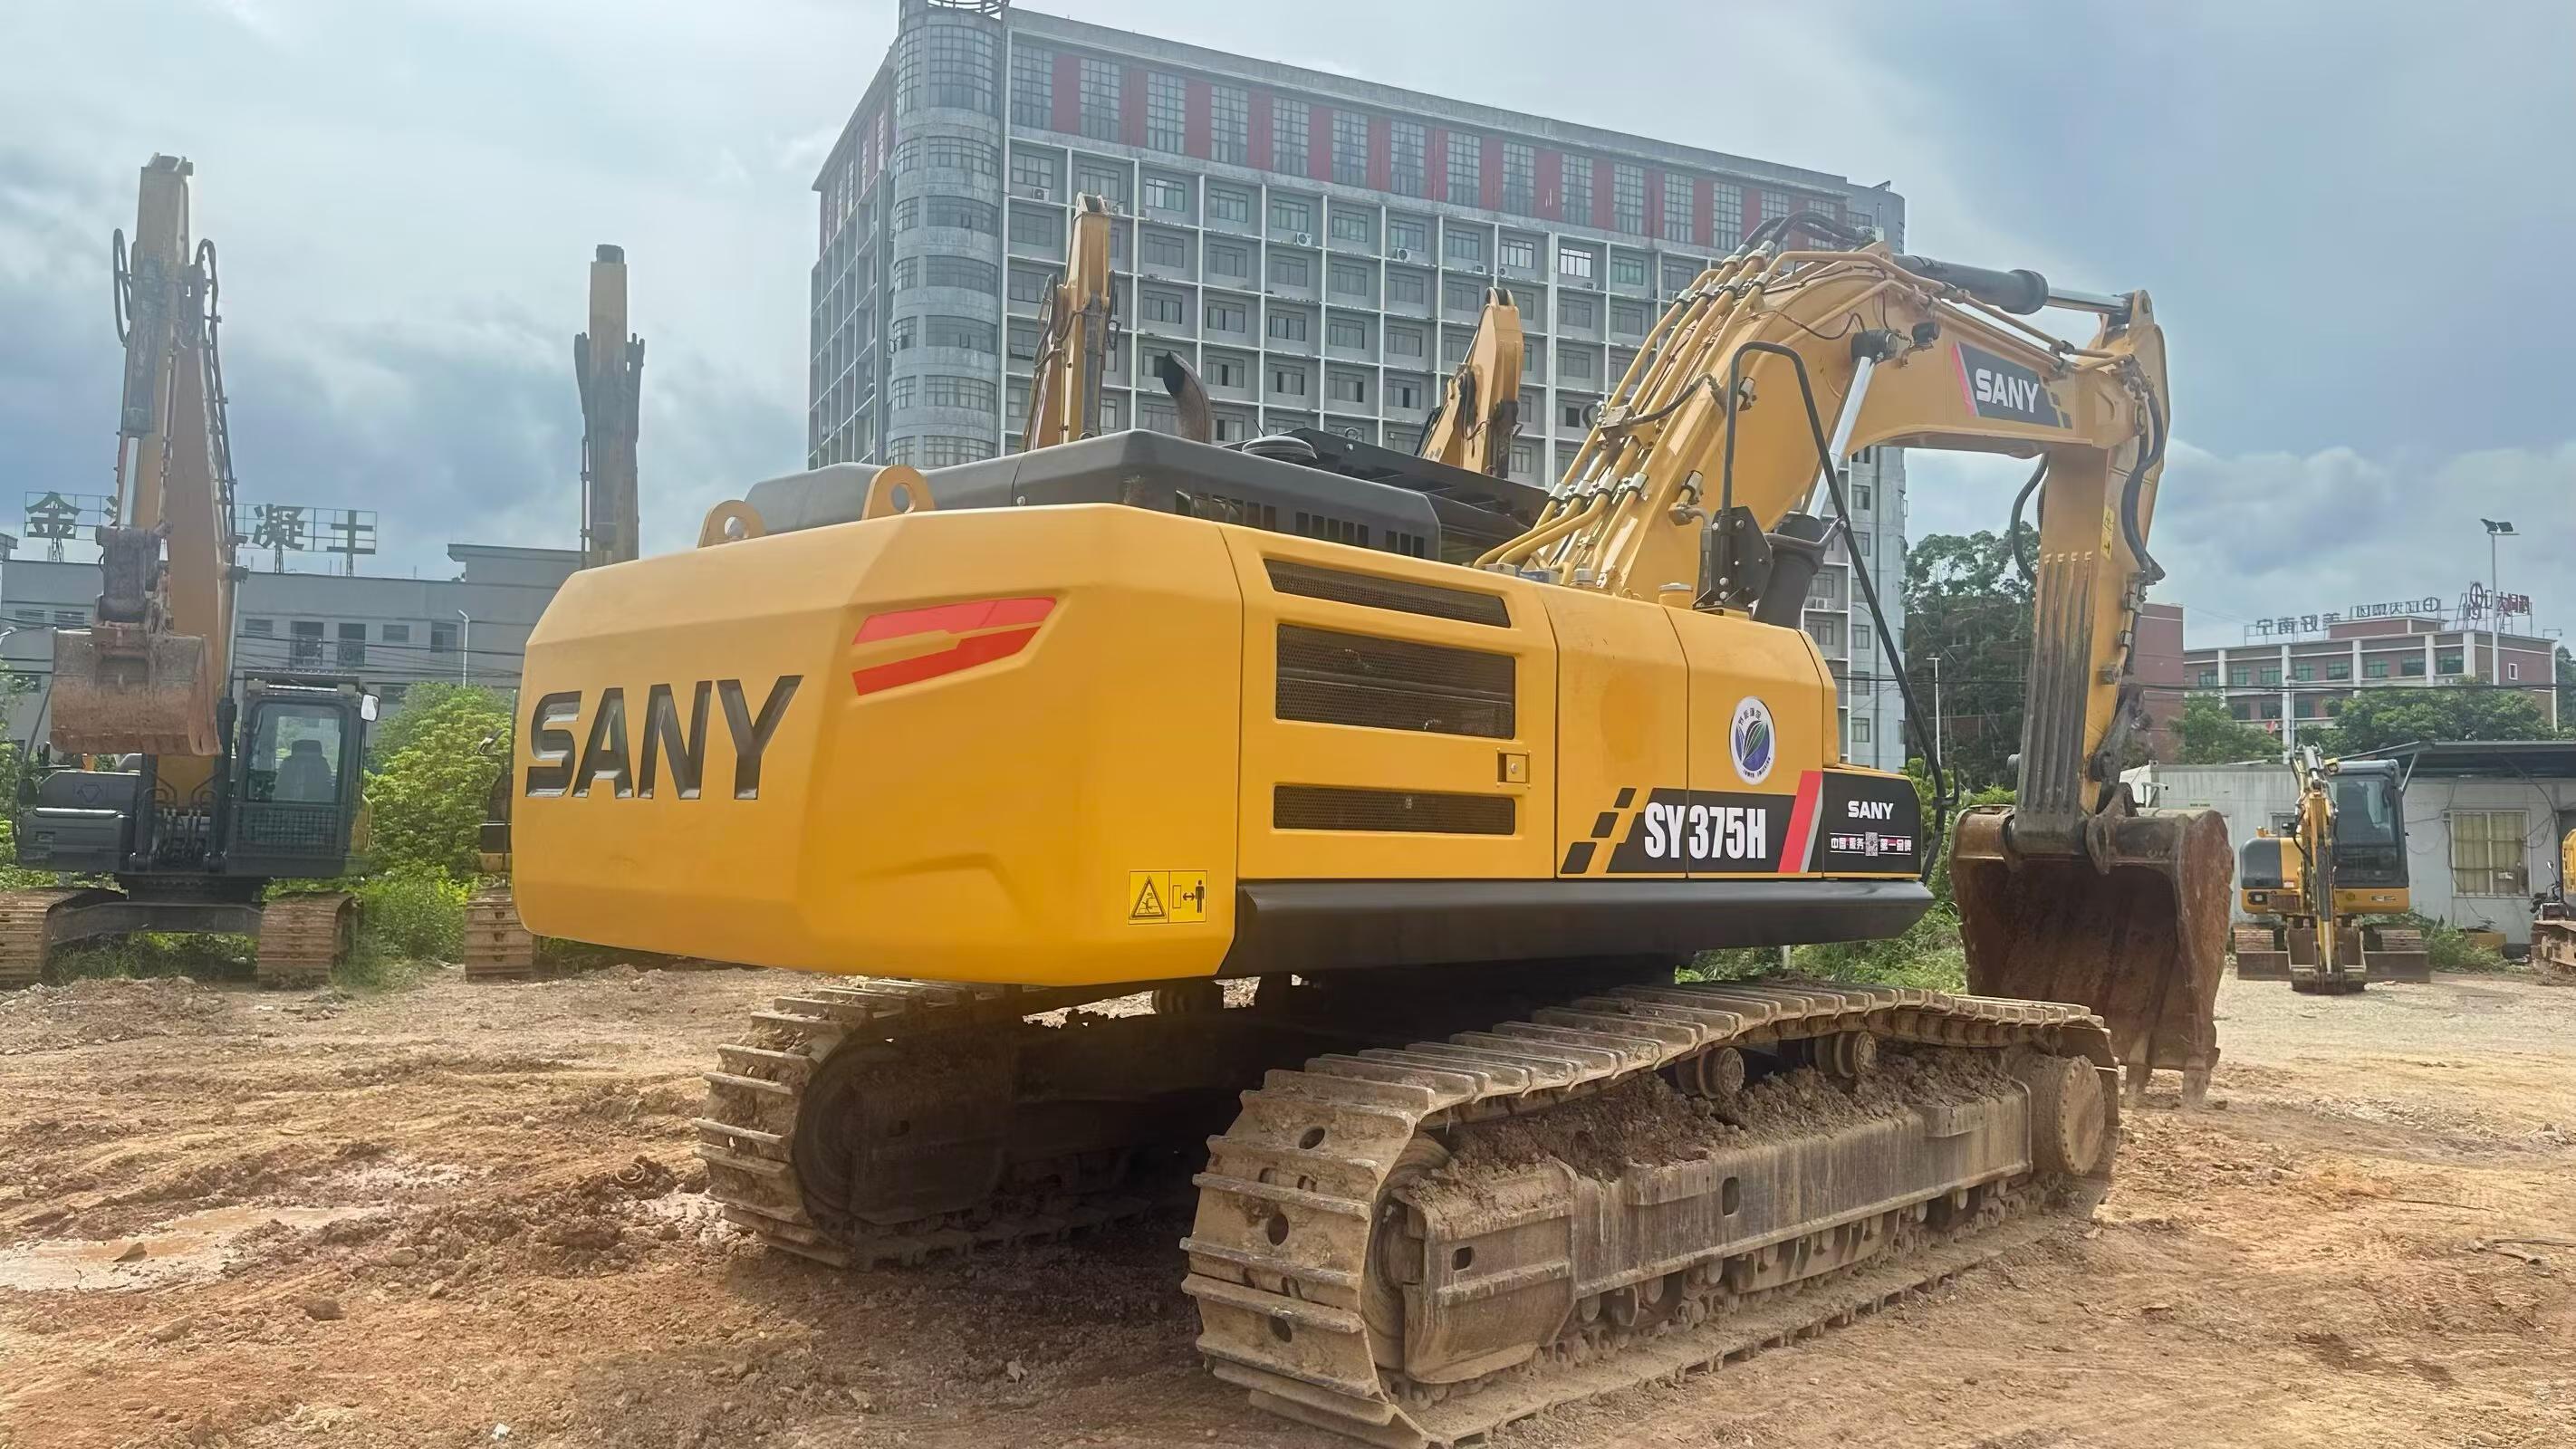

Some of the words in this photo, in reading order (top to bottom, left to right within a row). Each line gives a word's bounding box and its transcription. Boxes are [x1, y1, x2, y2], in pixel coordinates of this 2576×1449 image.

[1975, 368, 2039, 413] SANY
[524, 675, 804, 801] SANY
[1644, 801, 1766, 859] SY375H
[1848, 800, 1894, 820] SANY
